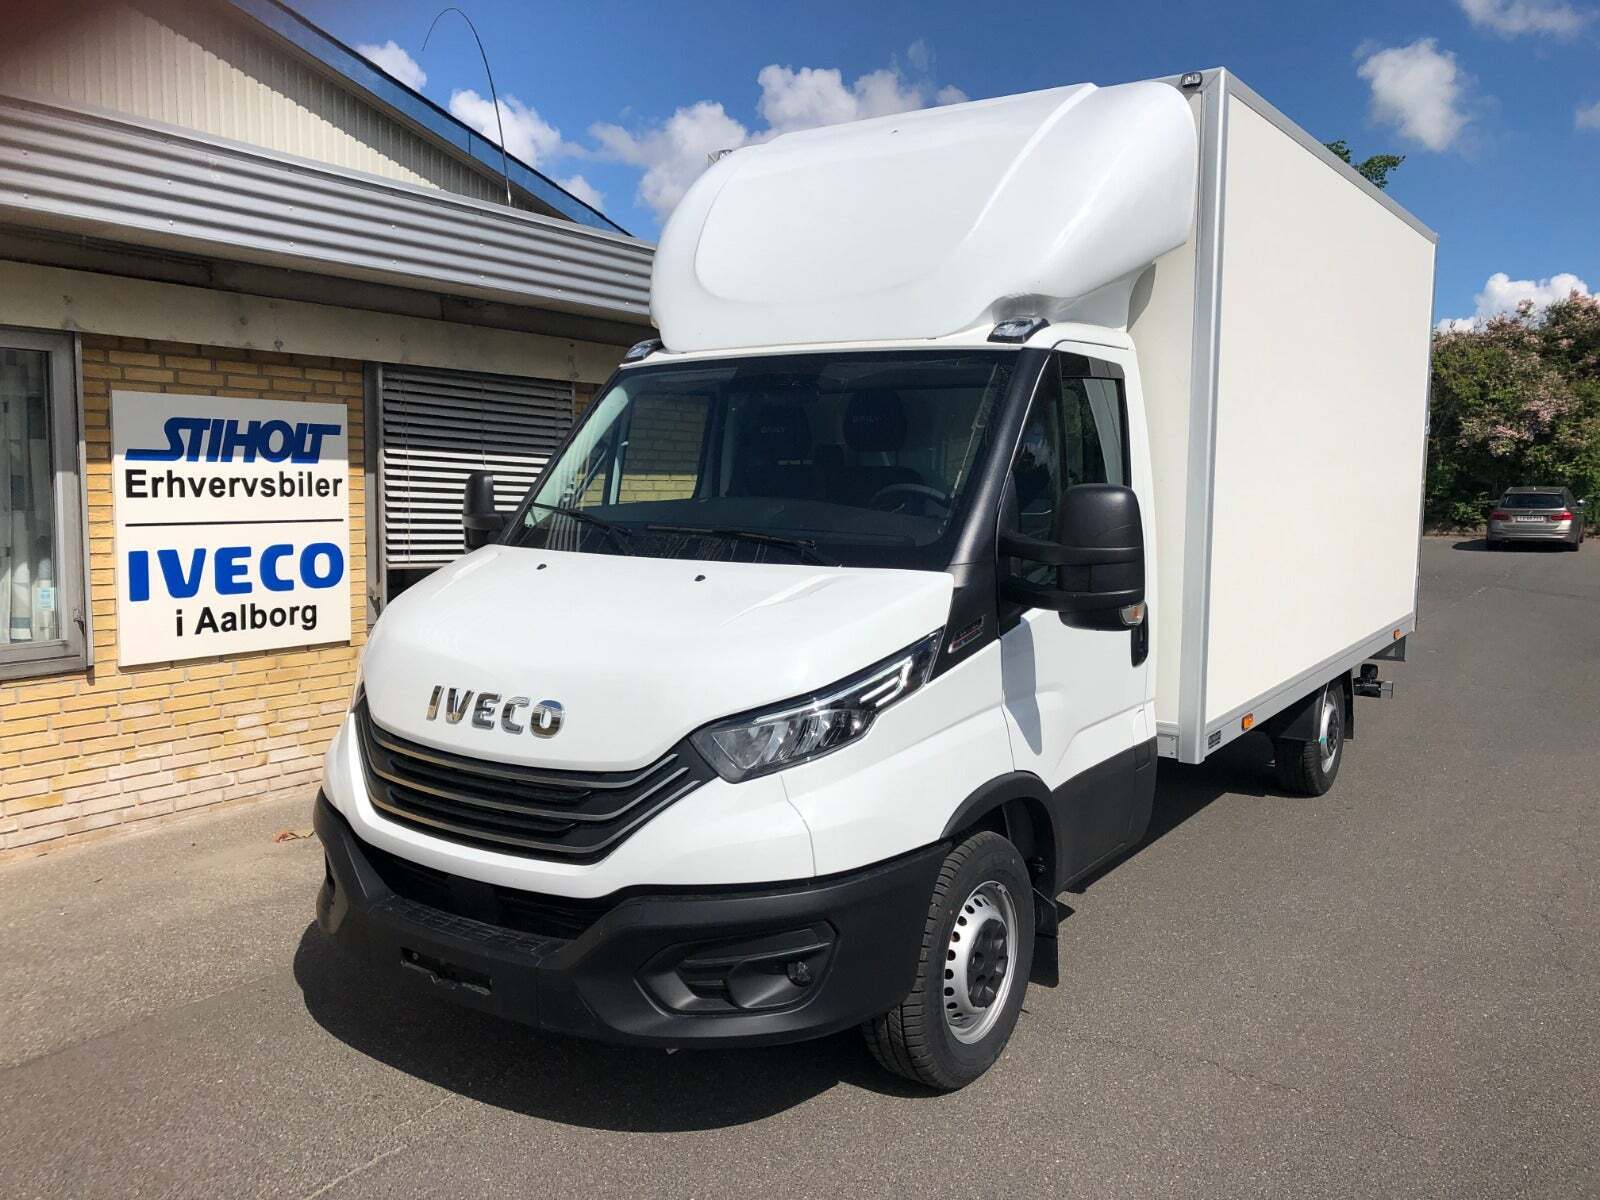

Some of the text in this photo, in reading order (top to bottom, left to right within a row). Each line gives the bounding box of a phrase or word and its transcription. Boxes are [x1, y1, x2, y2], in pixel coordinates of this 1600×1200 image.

[125, 417, 342, 464] STIHOLT
[125, 469, 342, 498] Erhvervsbiler
[128, 542, 344, 602] IVECO
[176, 603, 318, 637] i Aalborg
[426, 685, 565, 739] IVECO
